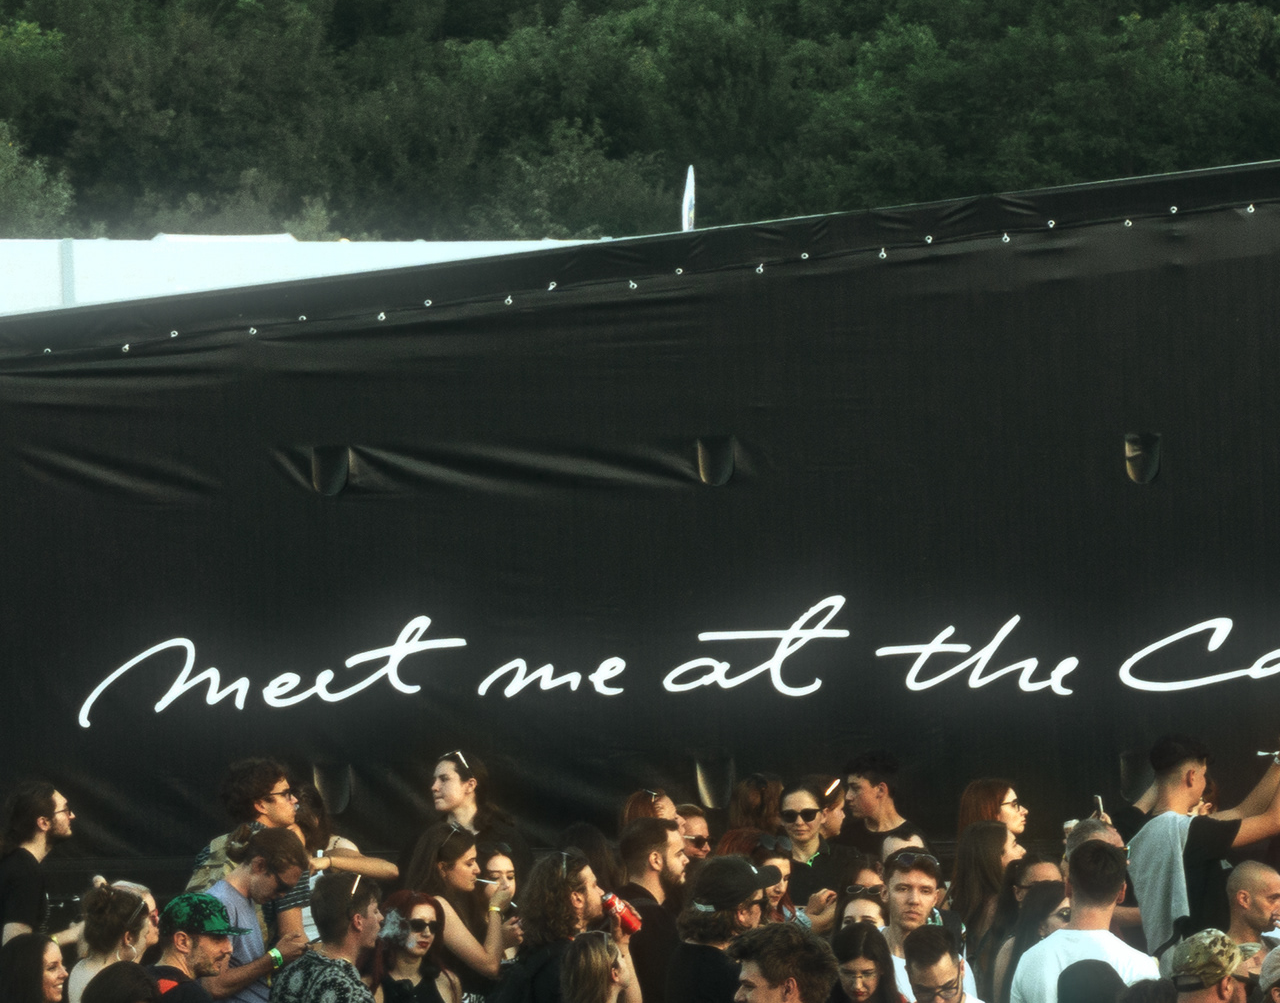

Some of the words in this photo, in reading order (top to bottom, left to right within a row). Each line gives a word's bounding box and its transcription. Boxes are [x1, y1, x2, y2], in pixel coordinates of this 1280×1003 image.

[478, 657, 626, 698] me
[663, 595, 850, 697] at
[876, 614, 1080, 696] the
